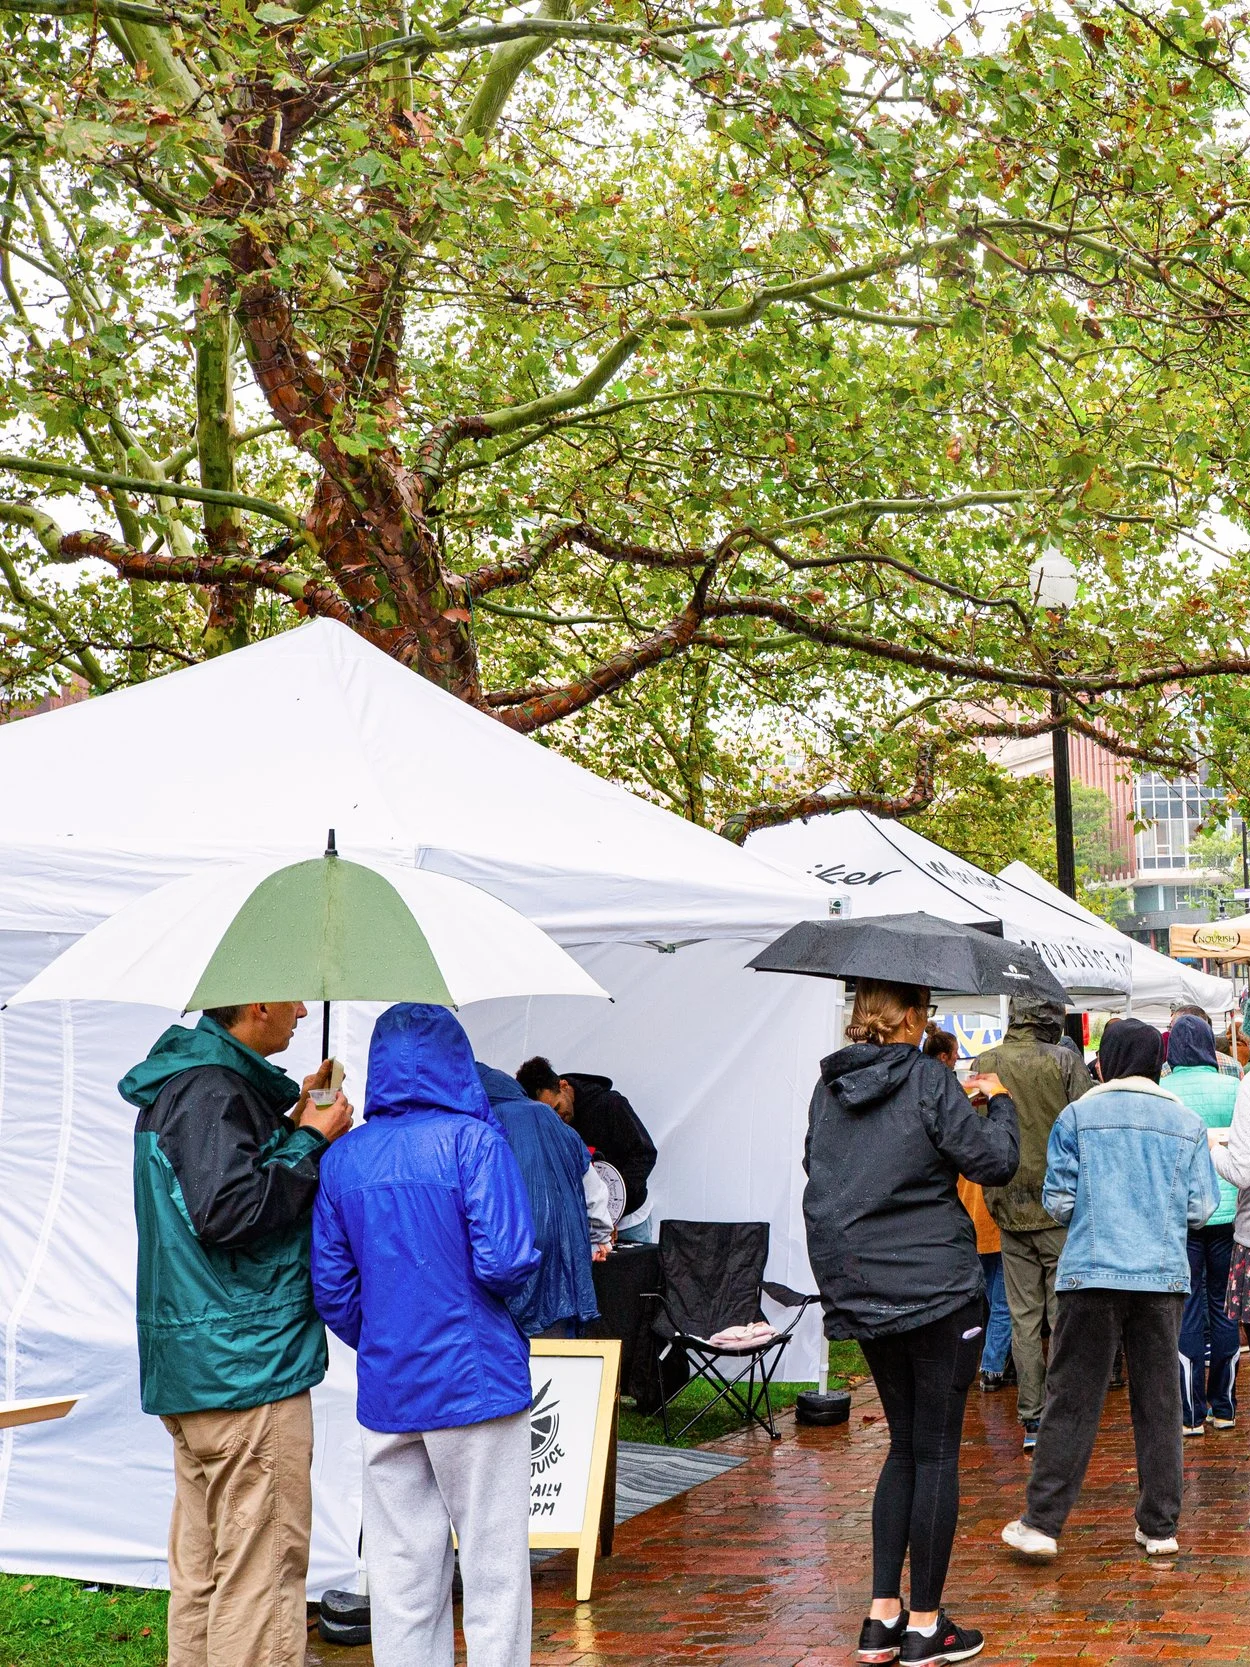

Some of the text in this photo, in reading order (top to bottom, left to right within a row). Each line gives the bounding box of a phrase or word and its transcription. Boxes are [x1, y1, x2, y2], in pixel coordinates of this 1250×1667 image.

[1198, 935, 1235, 944] NOURISH
[530, 1443, 566, 1478] JUICE
[529, 1482, 562, 1497] AILY
[528, 1502, 556, 1517] PM
